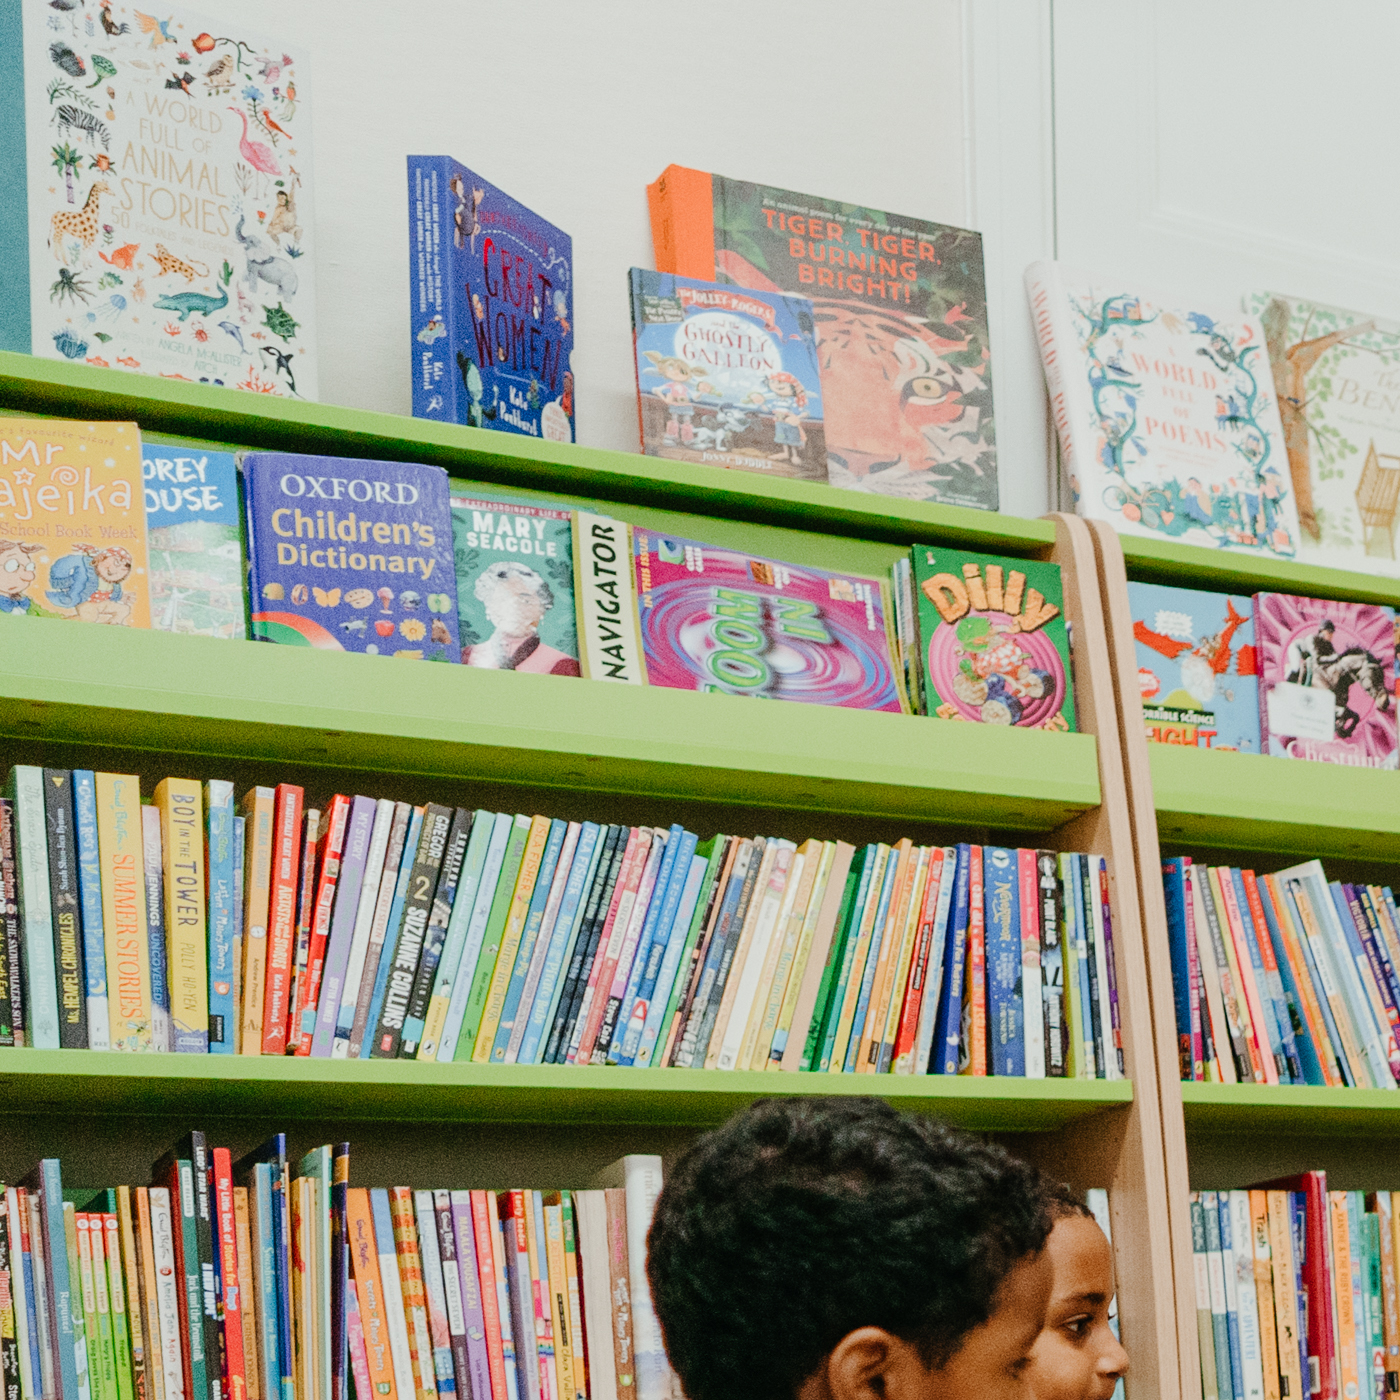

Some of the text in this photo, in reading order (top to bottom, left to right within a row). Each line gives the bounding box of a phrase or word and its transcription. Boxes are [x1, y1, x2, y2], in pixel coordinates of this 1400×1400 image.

[145, 92, 222, 134] WORLD
[140, 117, 212, 153] FULL OF
[122, 141, 227, 198] ANIMAL
[111, 206, 130, 229] 50
[120, 178, 230, 237] STORIES
[762, 208, 941, 266] TIGER, TIGER,
[789, 238, 918, 281] BURNING
[483, 237, 552, 325] GREAT
[798, 263, 910, 303] BRIGHT!
[158, 339, 193, 355] ANGELA
[465, 282, 562, 391] WOMEN
[682, 342, 774, 371] GALLEON
[684, 322, 769, 353] GHOSTLY
[1131, 351, 1219, 392] WORLD
[509, 384, 528, 411] Kate
[1161, 385, 1195, 405] FULL
[1, 440, 64, 466] Mr
[1144, 415, 1229, 454] POEMS
[280, 473, 420, 506] OXFORD
[0, 522, 137, 539] School Book Week
[270, 507, 436, 548] Children's
[466, 531, 558, 558] SEACOLE
[472, 511, 548, 540] MARY
[276, 542, 436, 581] Dictionary
[591, 523, 629, 681] NAVIGATOR
[429, 814, 450, 860] GREGOR
[171, 794, 199, 927] BOY TOWER
[520, 851, 540, 892] FISHER
[112, 854, 142, 1020] SUMMER STORIES
[382, 906, 428, 1030] SUZANNE COLLINS
